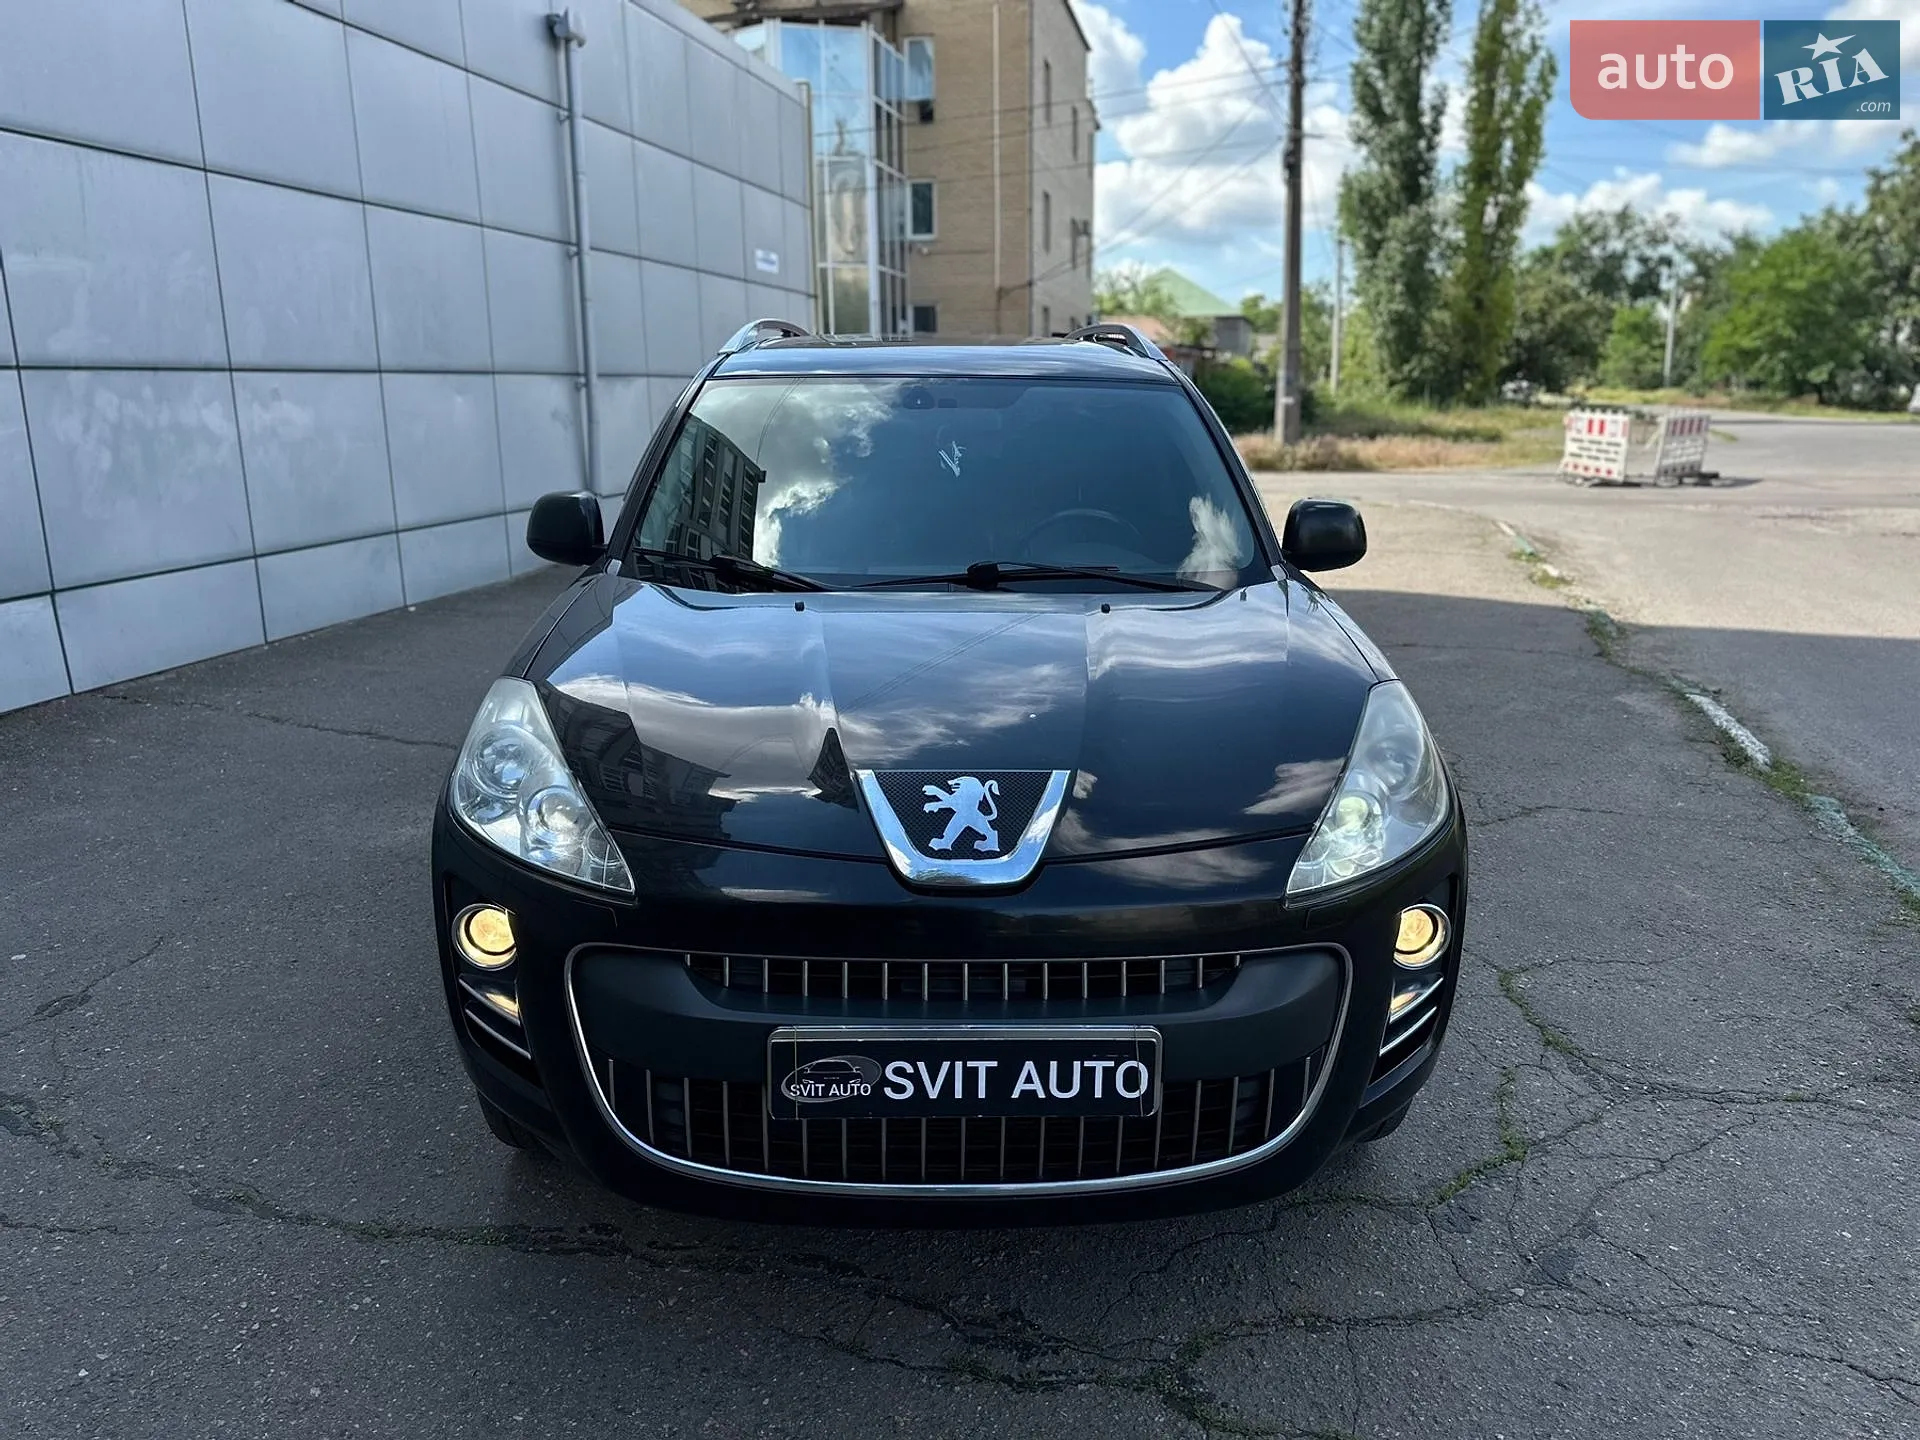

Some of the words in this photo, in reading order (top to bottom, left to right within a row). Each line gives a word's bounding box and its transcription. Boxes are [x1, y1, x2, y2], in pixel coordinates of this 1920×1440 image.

[789, 1083, 825, 1097] SVIT
[828, 1083, 871, 1097] AUTO
[884, 1061, 998, 1099] SVIT
[1010, 1060, 1149, 1099] AUTO
